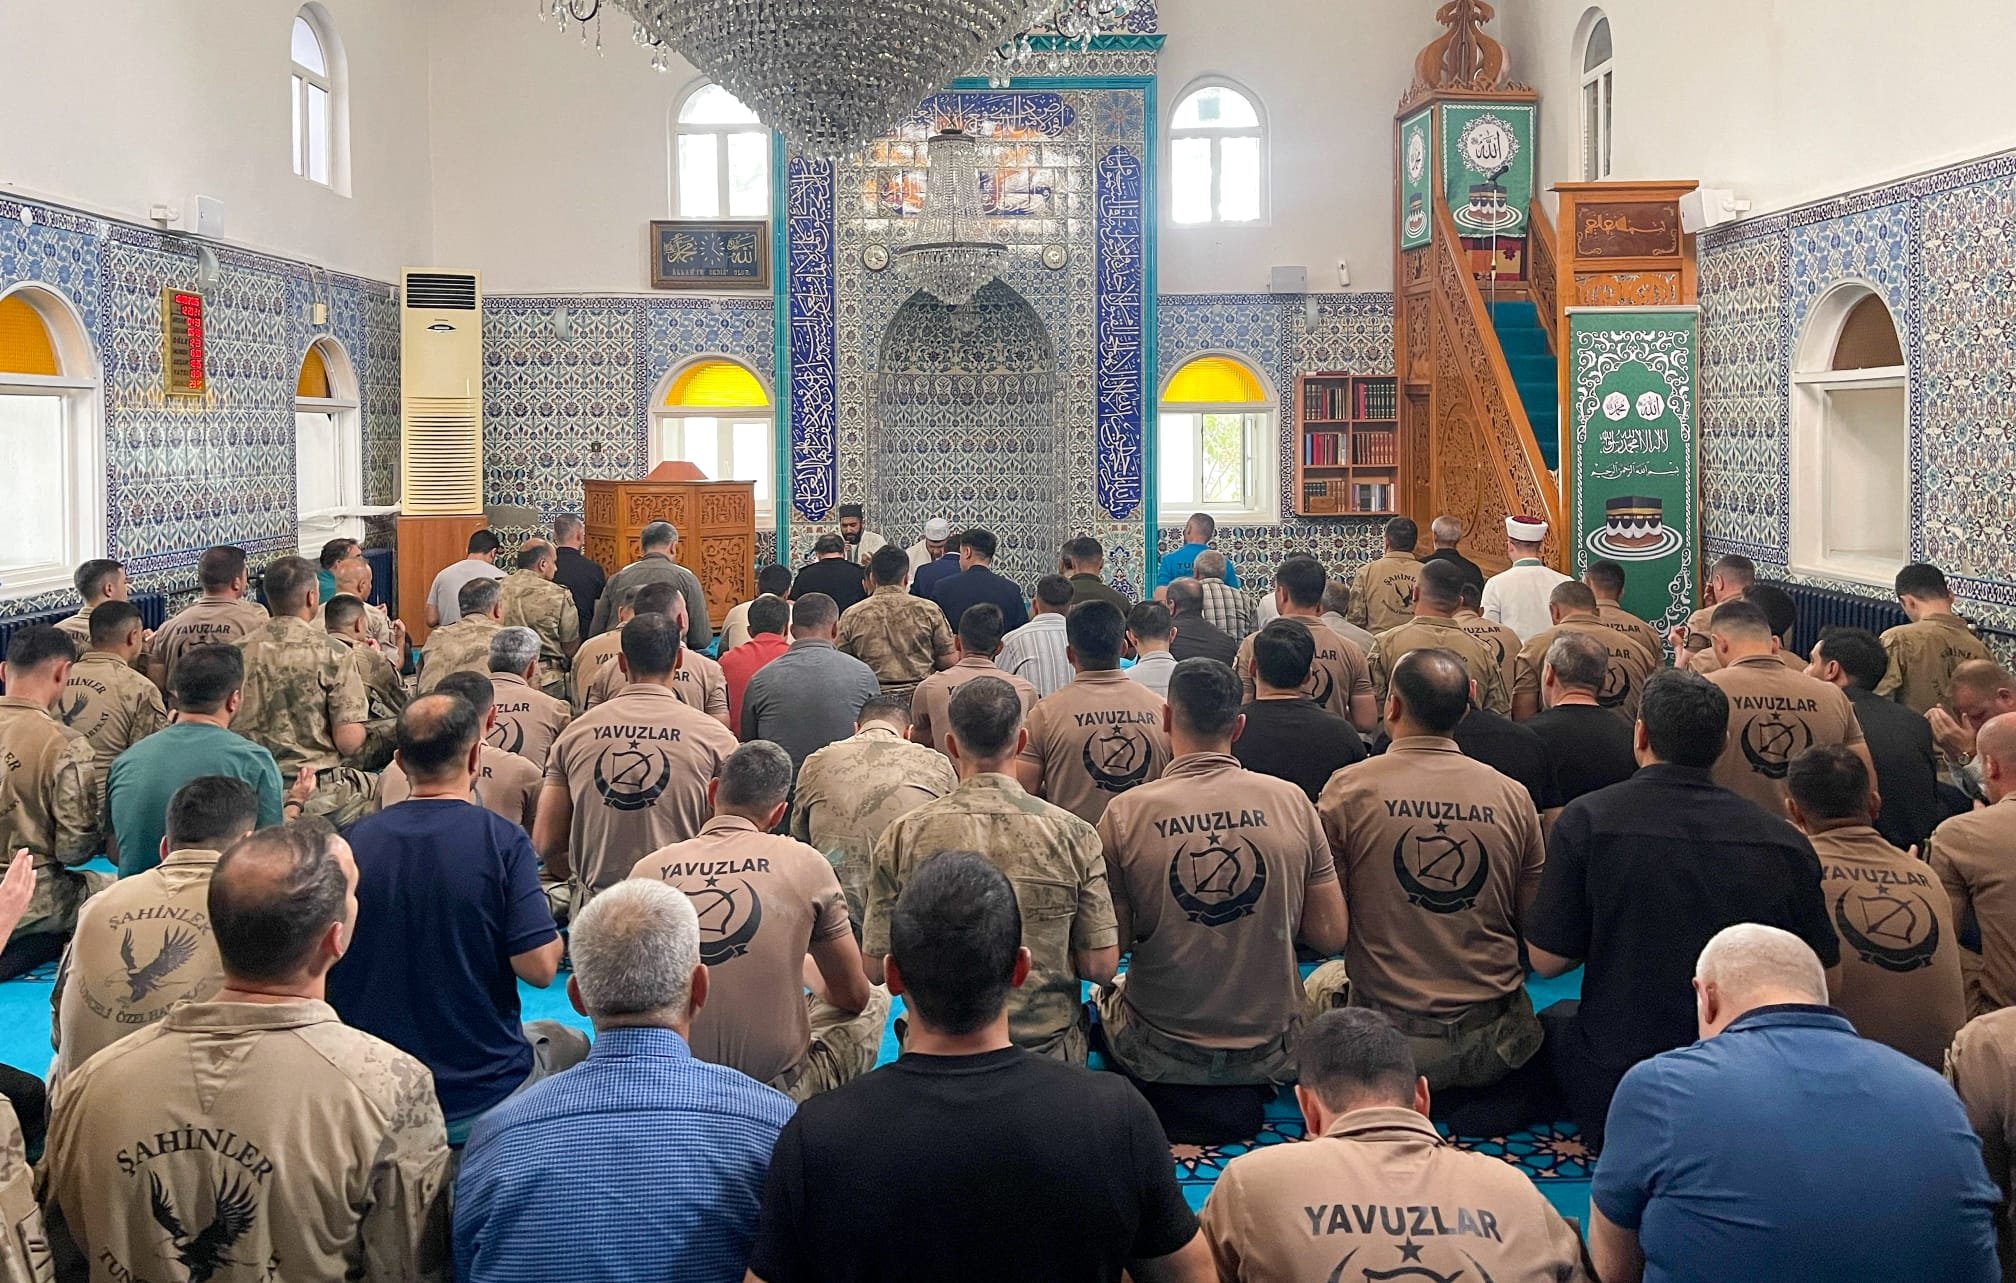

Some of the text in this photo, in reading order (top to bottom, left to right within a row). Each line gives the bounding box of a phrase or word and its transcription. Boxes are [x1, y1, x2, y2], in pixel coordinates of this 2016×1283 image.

[175, 623, 230, 635] YAVUZLAR
[1464, 626, 1501, 635] UZLAR
[66, 676, 107, 695] HİNLER
[496, 702, 530, 713] ZLAR
[1733, 696, 1818, 713] YAVUZLAR
[1074, 710, 1156, 727] YAVUZLAR
[593, 725, 681, 742] YAVUZLAR
[1384, 799, 1496, 825] YAVUZLAR
[1154, 809, 1268, 838] YAVUZLAR
[660, 857, 770, 881] YAVUZLAR
[116, 1123, 273, 1185] ŞAHİNLER
[1304, 1204, 1503, 1244] YAVUZLAR
